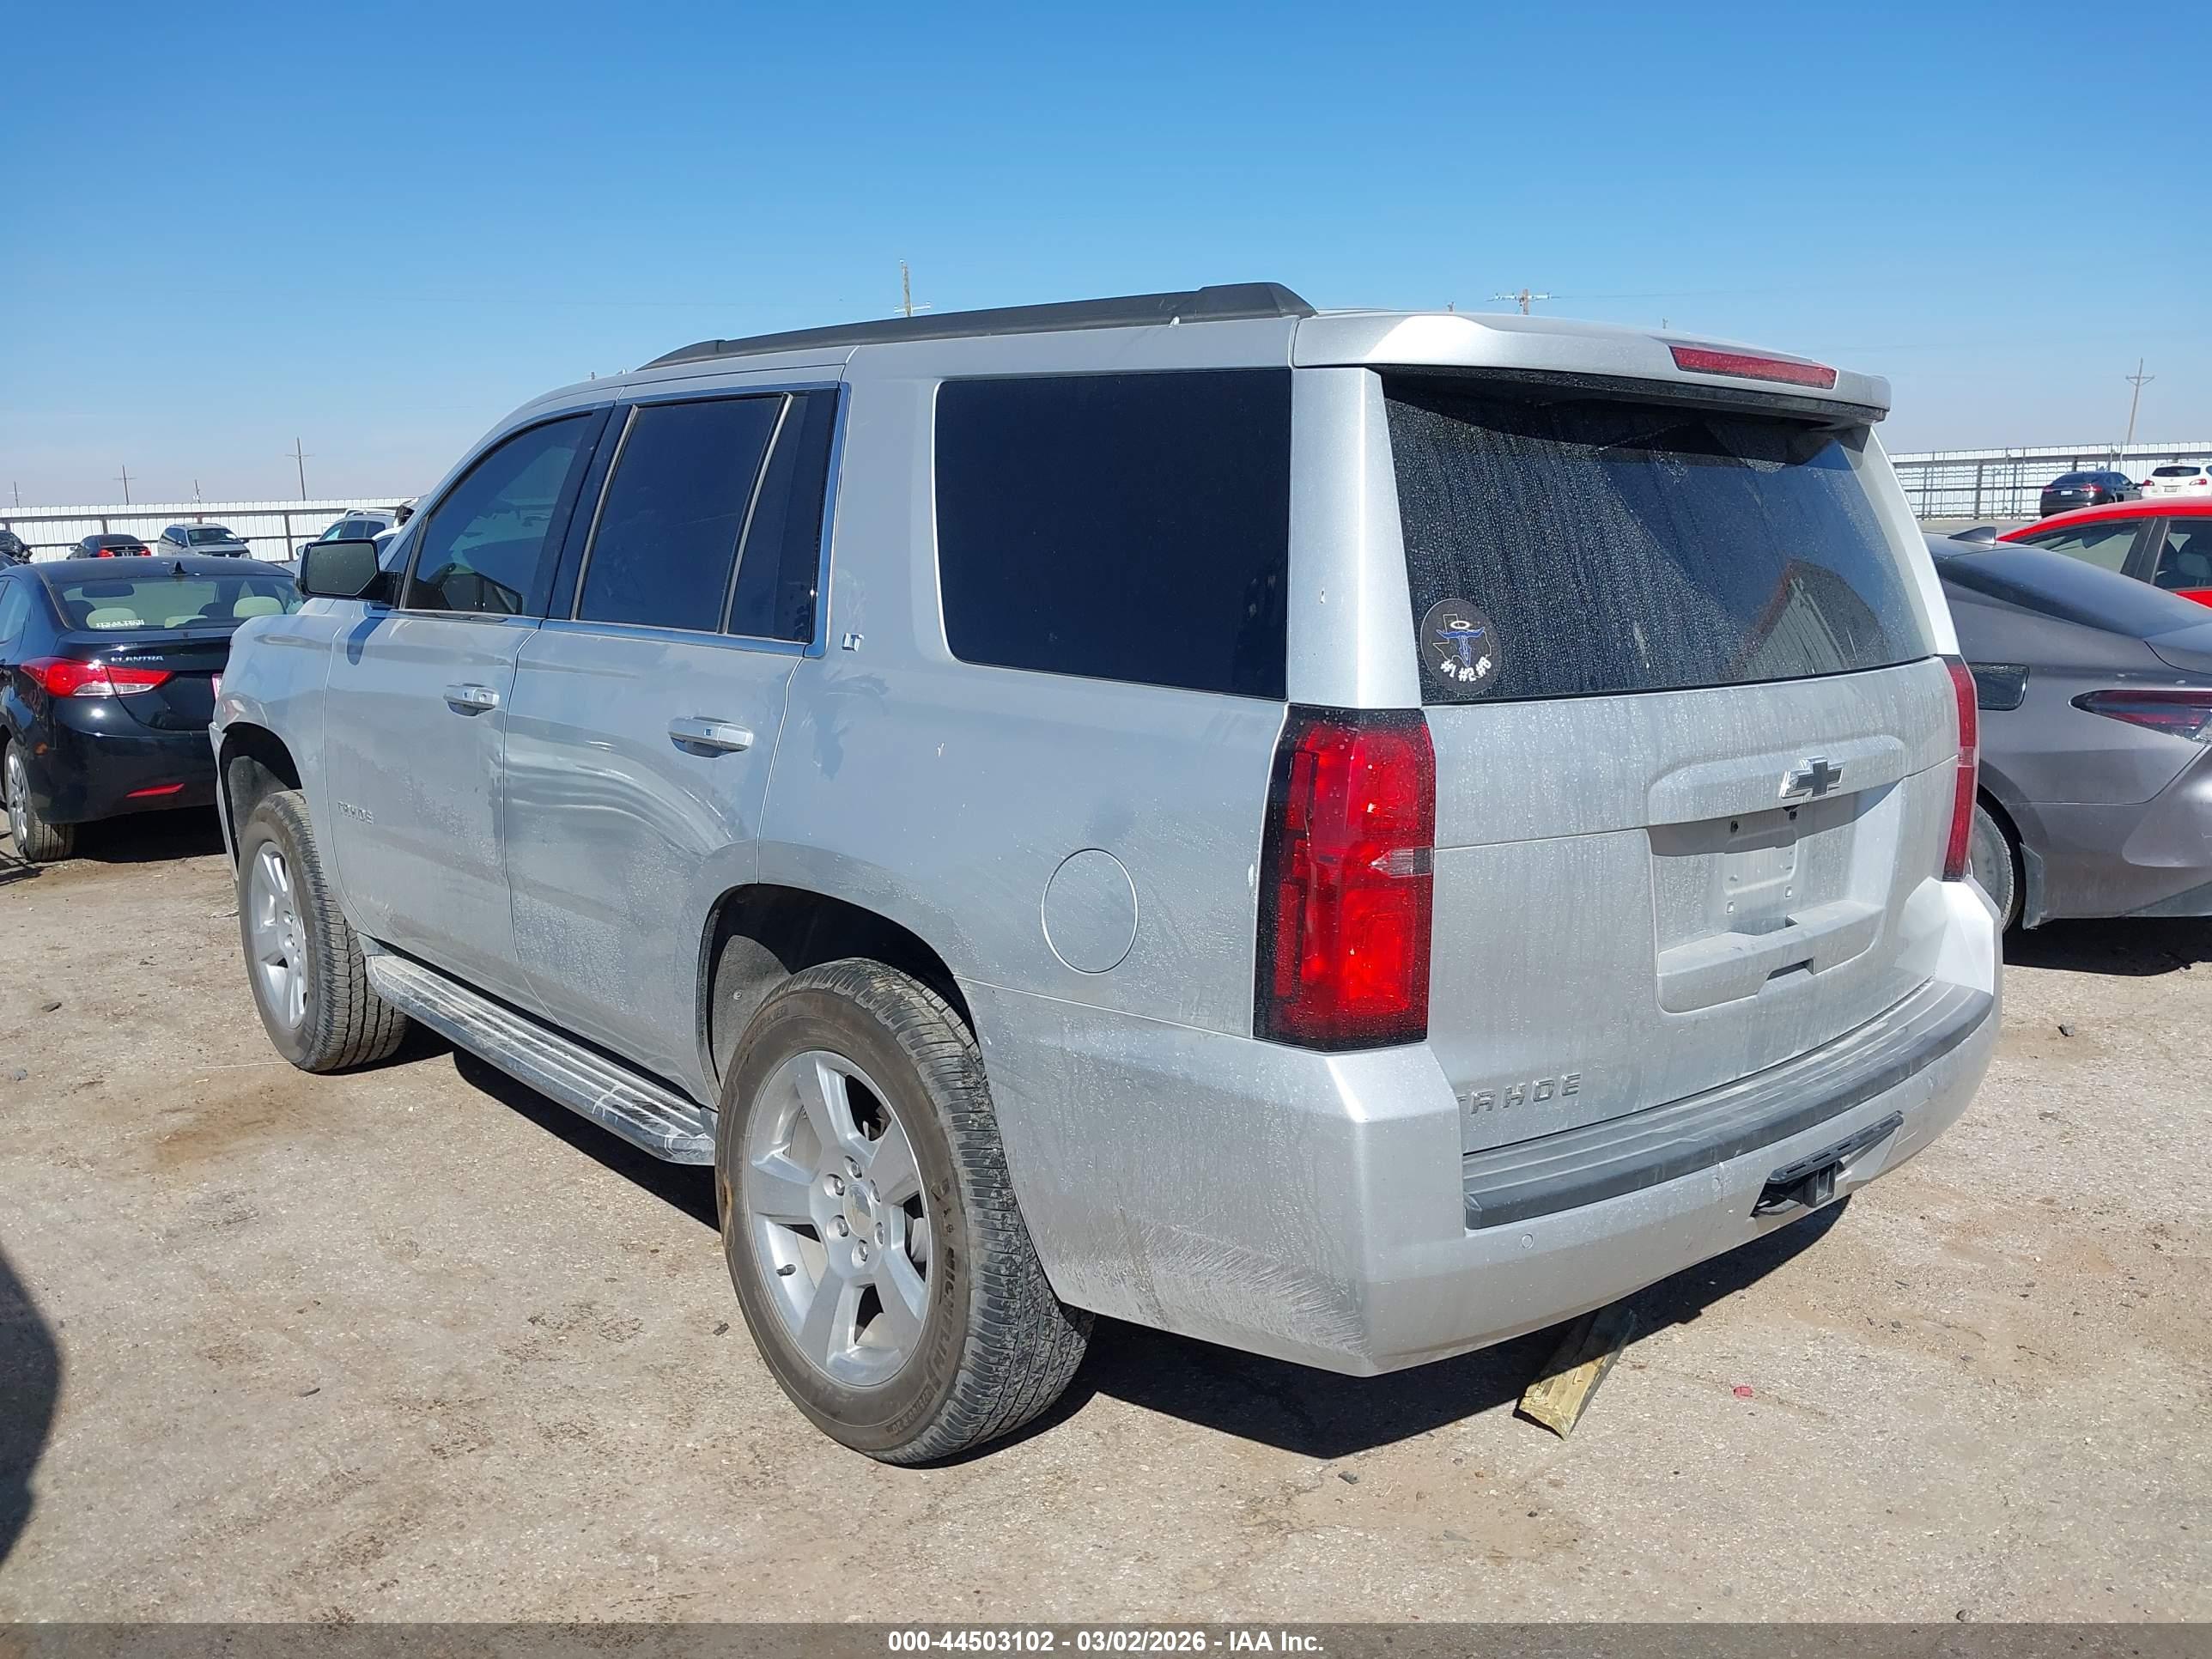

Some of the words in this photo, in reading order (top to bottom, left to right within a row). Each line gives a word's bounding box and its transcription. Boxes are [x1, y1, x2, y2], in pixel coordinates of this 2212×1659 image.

[842, 633, 865, 653] LT
[1440, 660, 1457, 678] #1
[1458, 666, 1477, 682] #2
